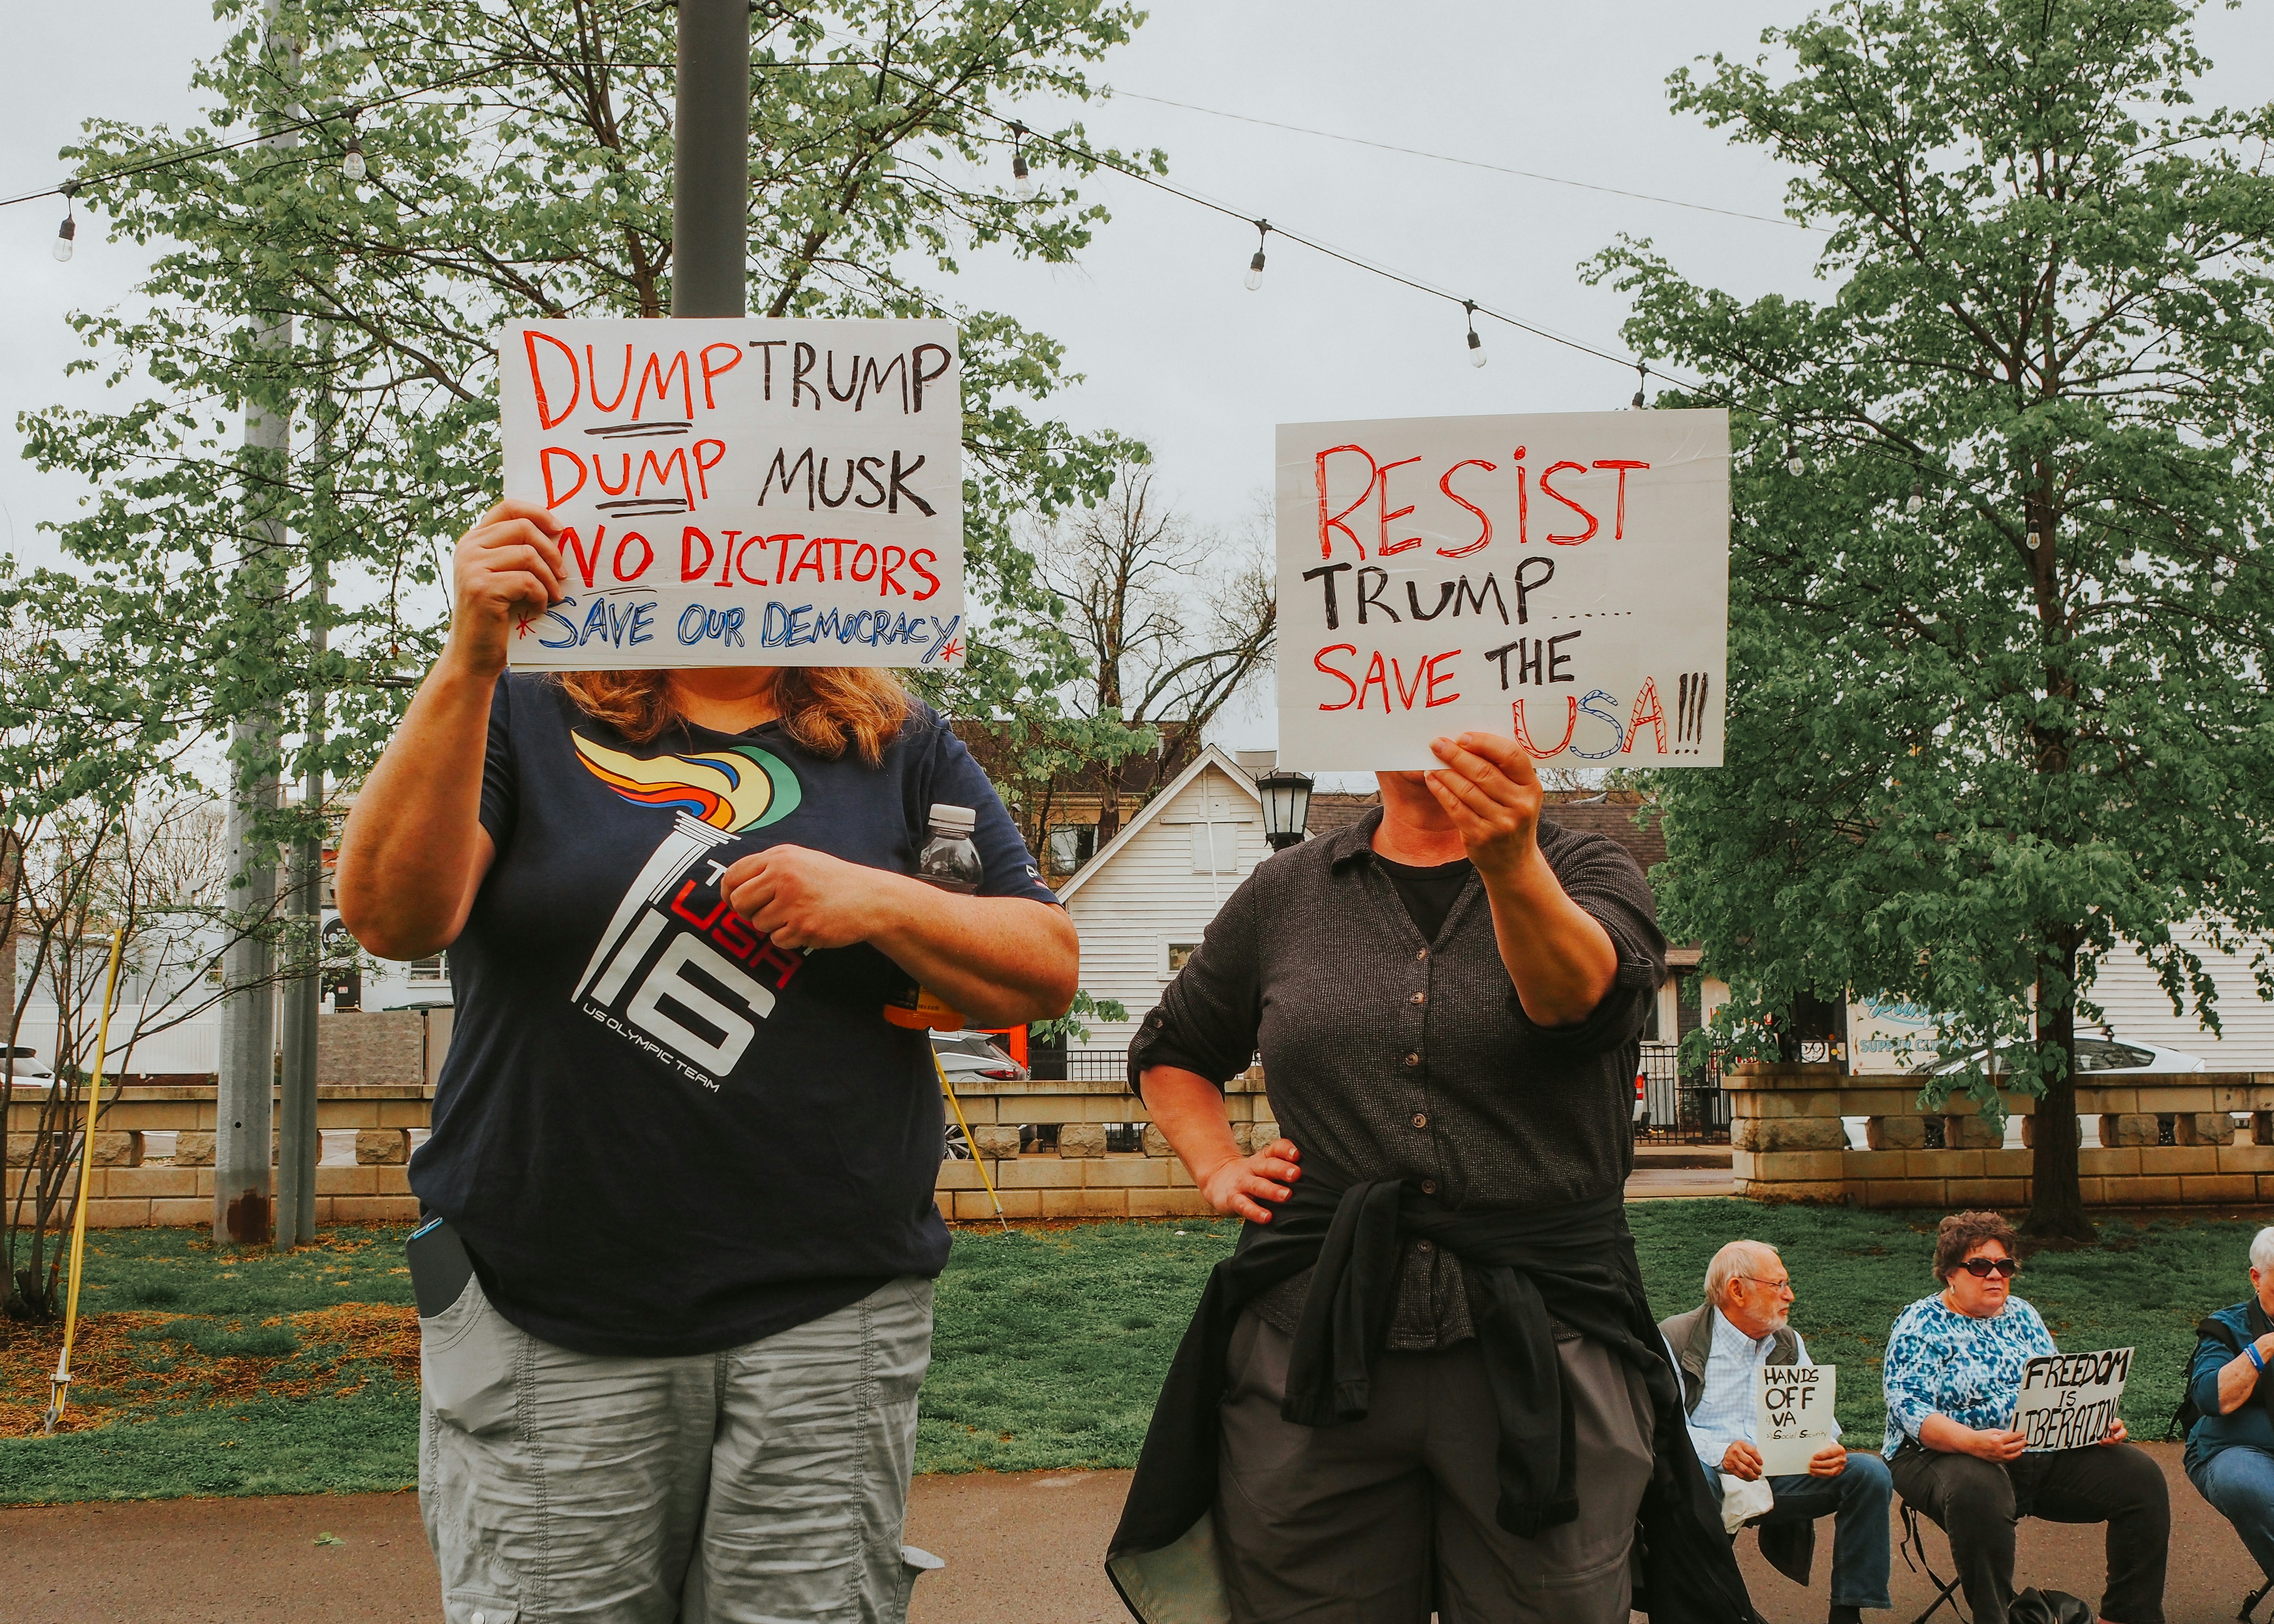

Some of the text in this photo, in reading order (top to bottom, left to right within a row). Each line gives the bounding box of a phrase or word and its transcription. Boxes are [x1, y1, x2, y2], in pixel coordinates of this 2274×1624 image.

[523, 330, 952, 430] DUMP TRUMP
[540, 438, 937, 517] DUMP MUSK
[557, 524, 941, 601] NO DICTATORS
[538, 596, 960, 664] SAVE OUR DEMOCRACY
[1314, 630, 1582, 714] SAVE THE
[1512, 672, 1709, 760] USA!!!
[323, 933, 353, 943] LOC
[670, 879, 803, 990] USA
[590, 907, 776, 1077] 16
[583, 1002, 720, 1093] US OLYMPIC TEAM
[1764, 1367, 1819, 1385] HANDS
[1765, 1386, 1815, 1410] OFF
[2023, 1349, 2130, 1390] FREEDOM
[2058, 1390, 2077, 1407] IS
[1772, 1411, 1796, 1427] VA
[1772, 1429, 1797, 1439] Social
